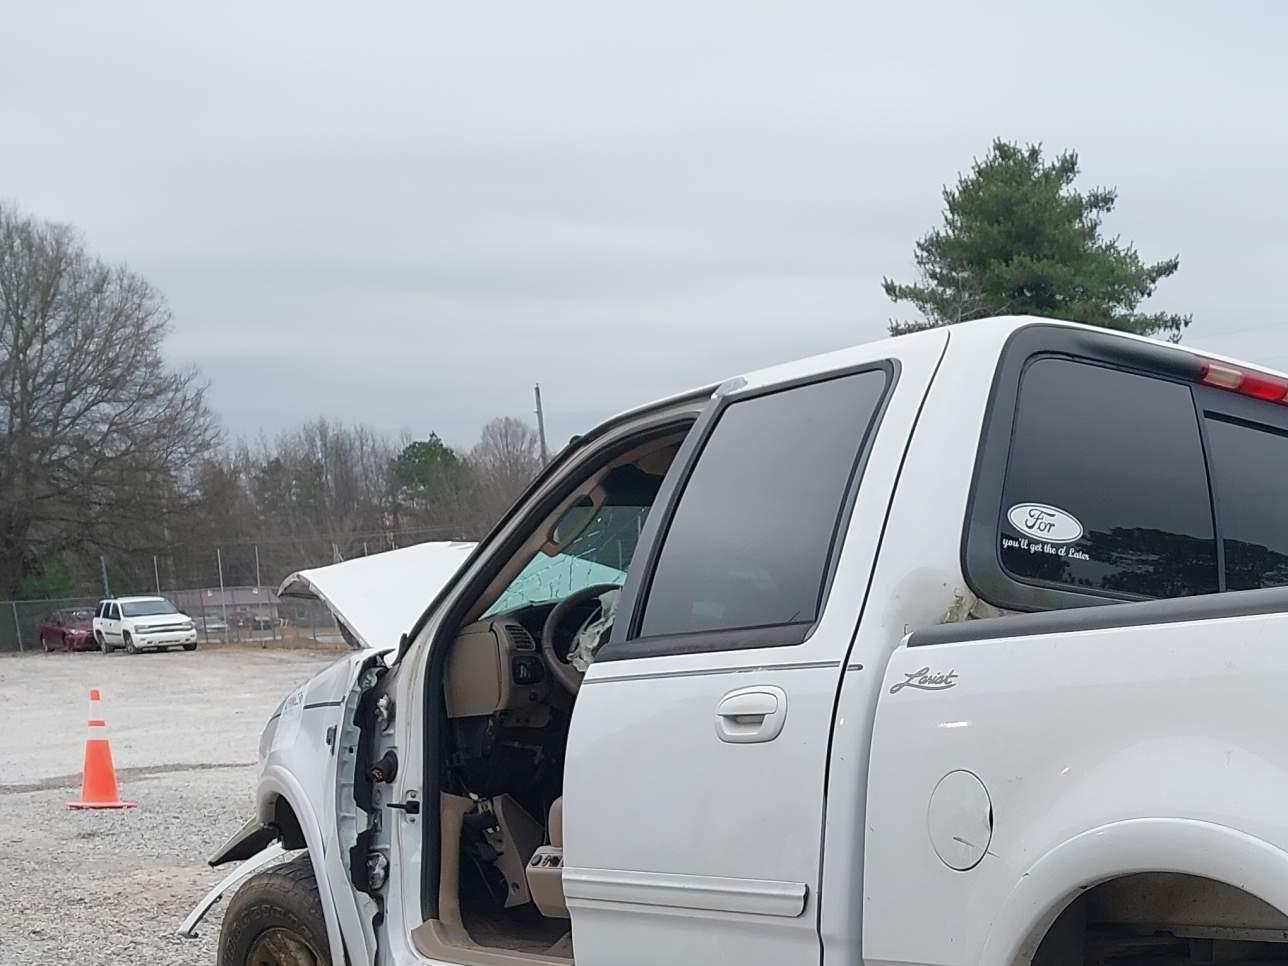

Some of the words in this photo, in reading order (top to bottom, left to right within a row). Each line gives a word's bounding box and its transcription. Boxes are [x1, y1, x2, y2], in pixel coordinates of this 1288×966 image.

[1025, 508, 1056, 534] For
[1002, 538, 1029, 550] you'll
[1030, 543, 1043, 554] get
[1044, 544, 1057, 555] the
